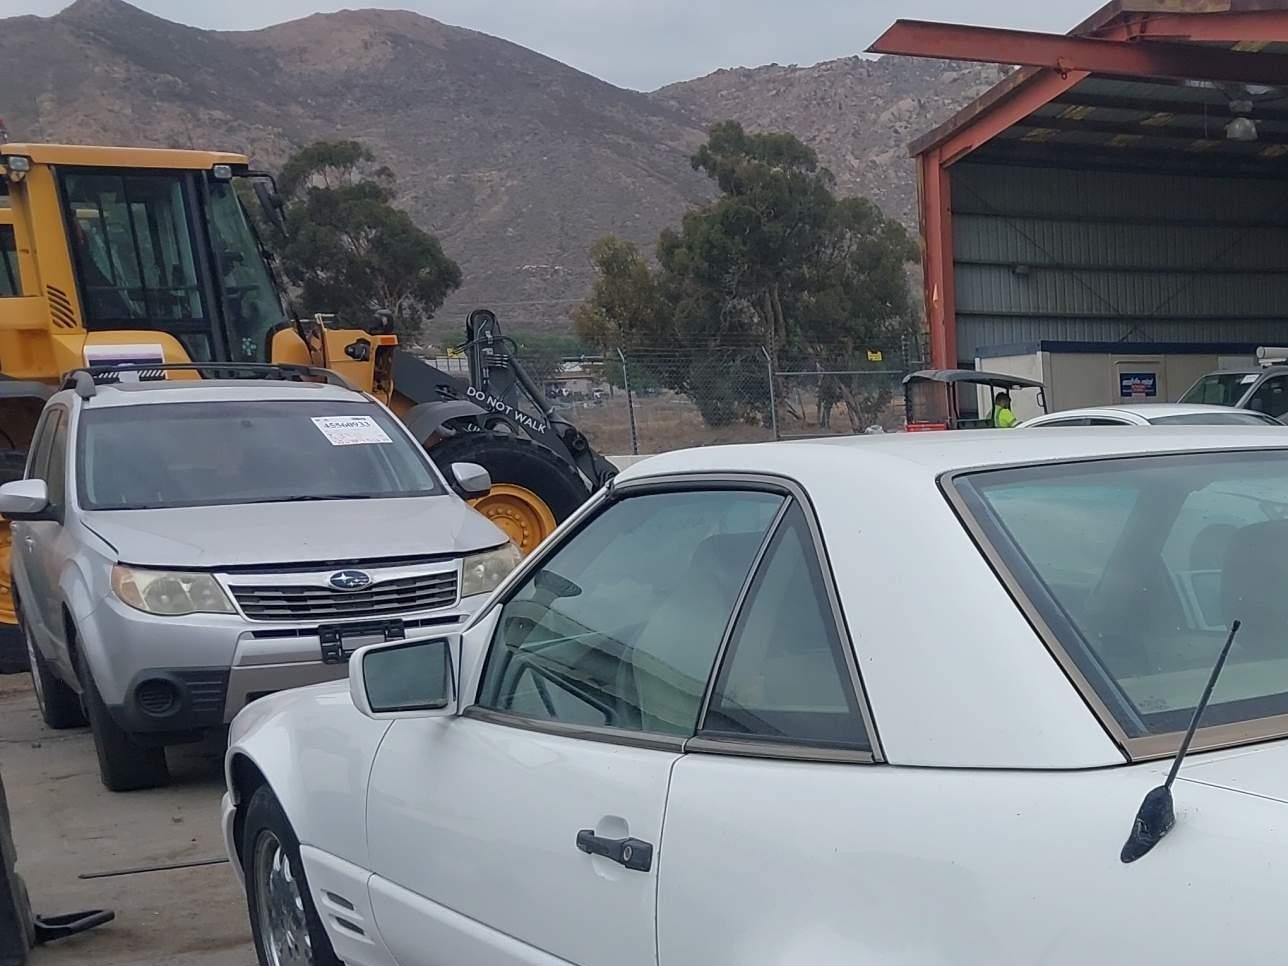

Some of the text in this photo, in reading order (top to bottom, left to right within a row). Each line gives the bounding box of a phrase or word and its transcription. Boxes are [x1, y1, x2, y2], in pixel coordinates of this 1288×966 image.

[467, 386, 547, 434] DO NOT WALK
